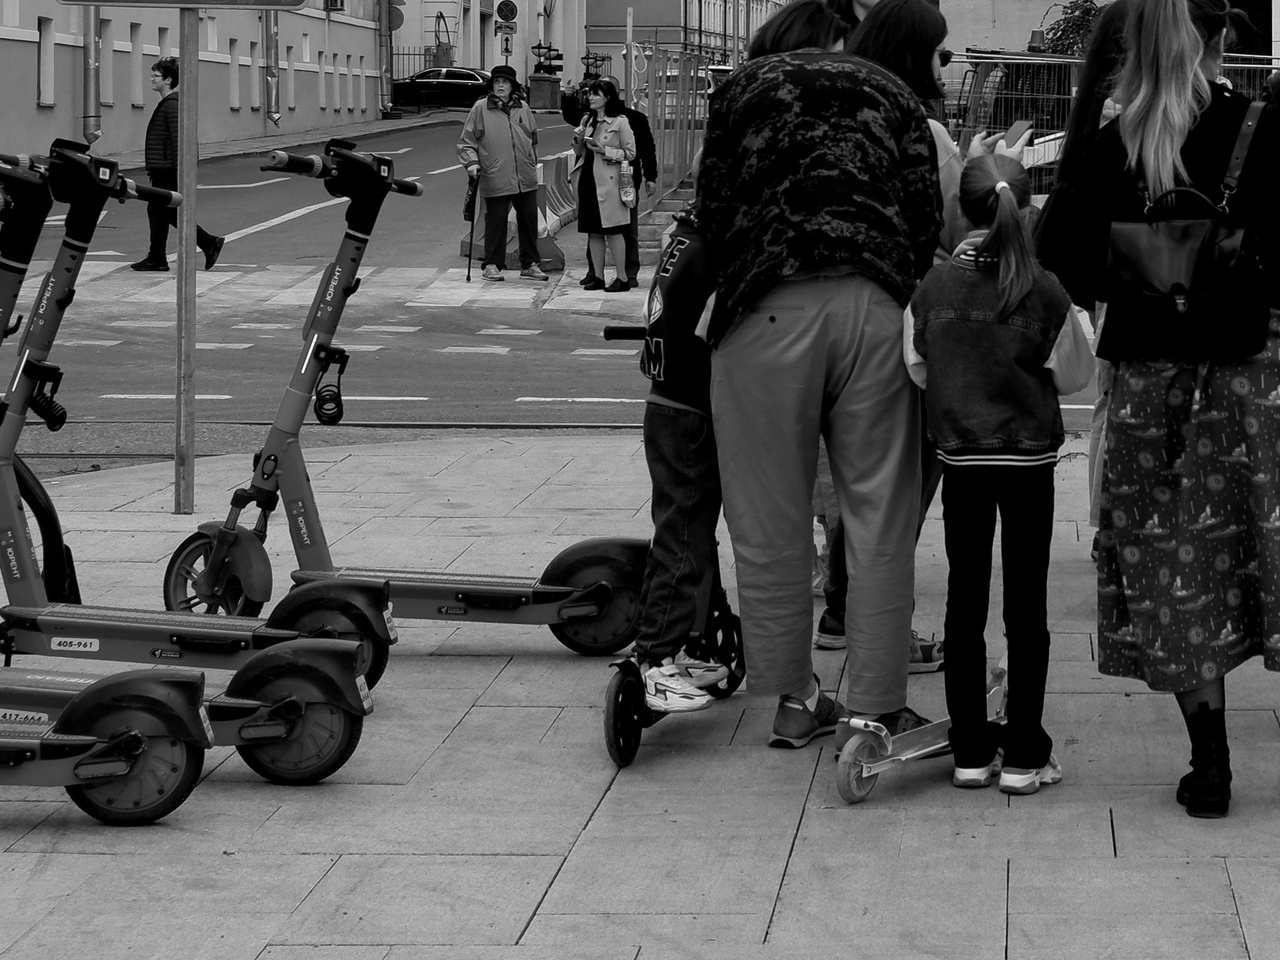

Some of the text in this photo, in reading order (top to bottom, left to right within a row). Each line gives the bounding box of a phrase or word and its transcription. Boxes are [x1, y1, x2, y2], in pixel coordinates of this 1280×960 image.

[38, 276, 56, 315] ЮРЕНТ
[325, 265, 343, 302] ЮРЕНТ
[56, 640, 94, 648] 405-961
